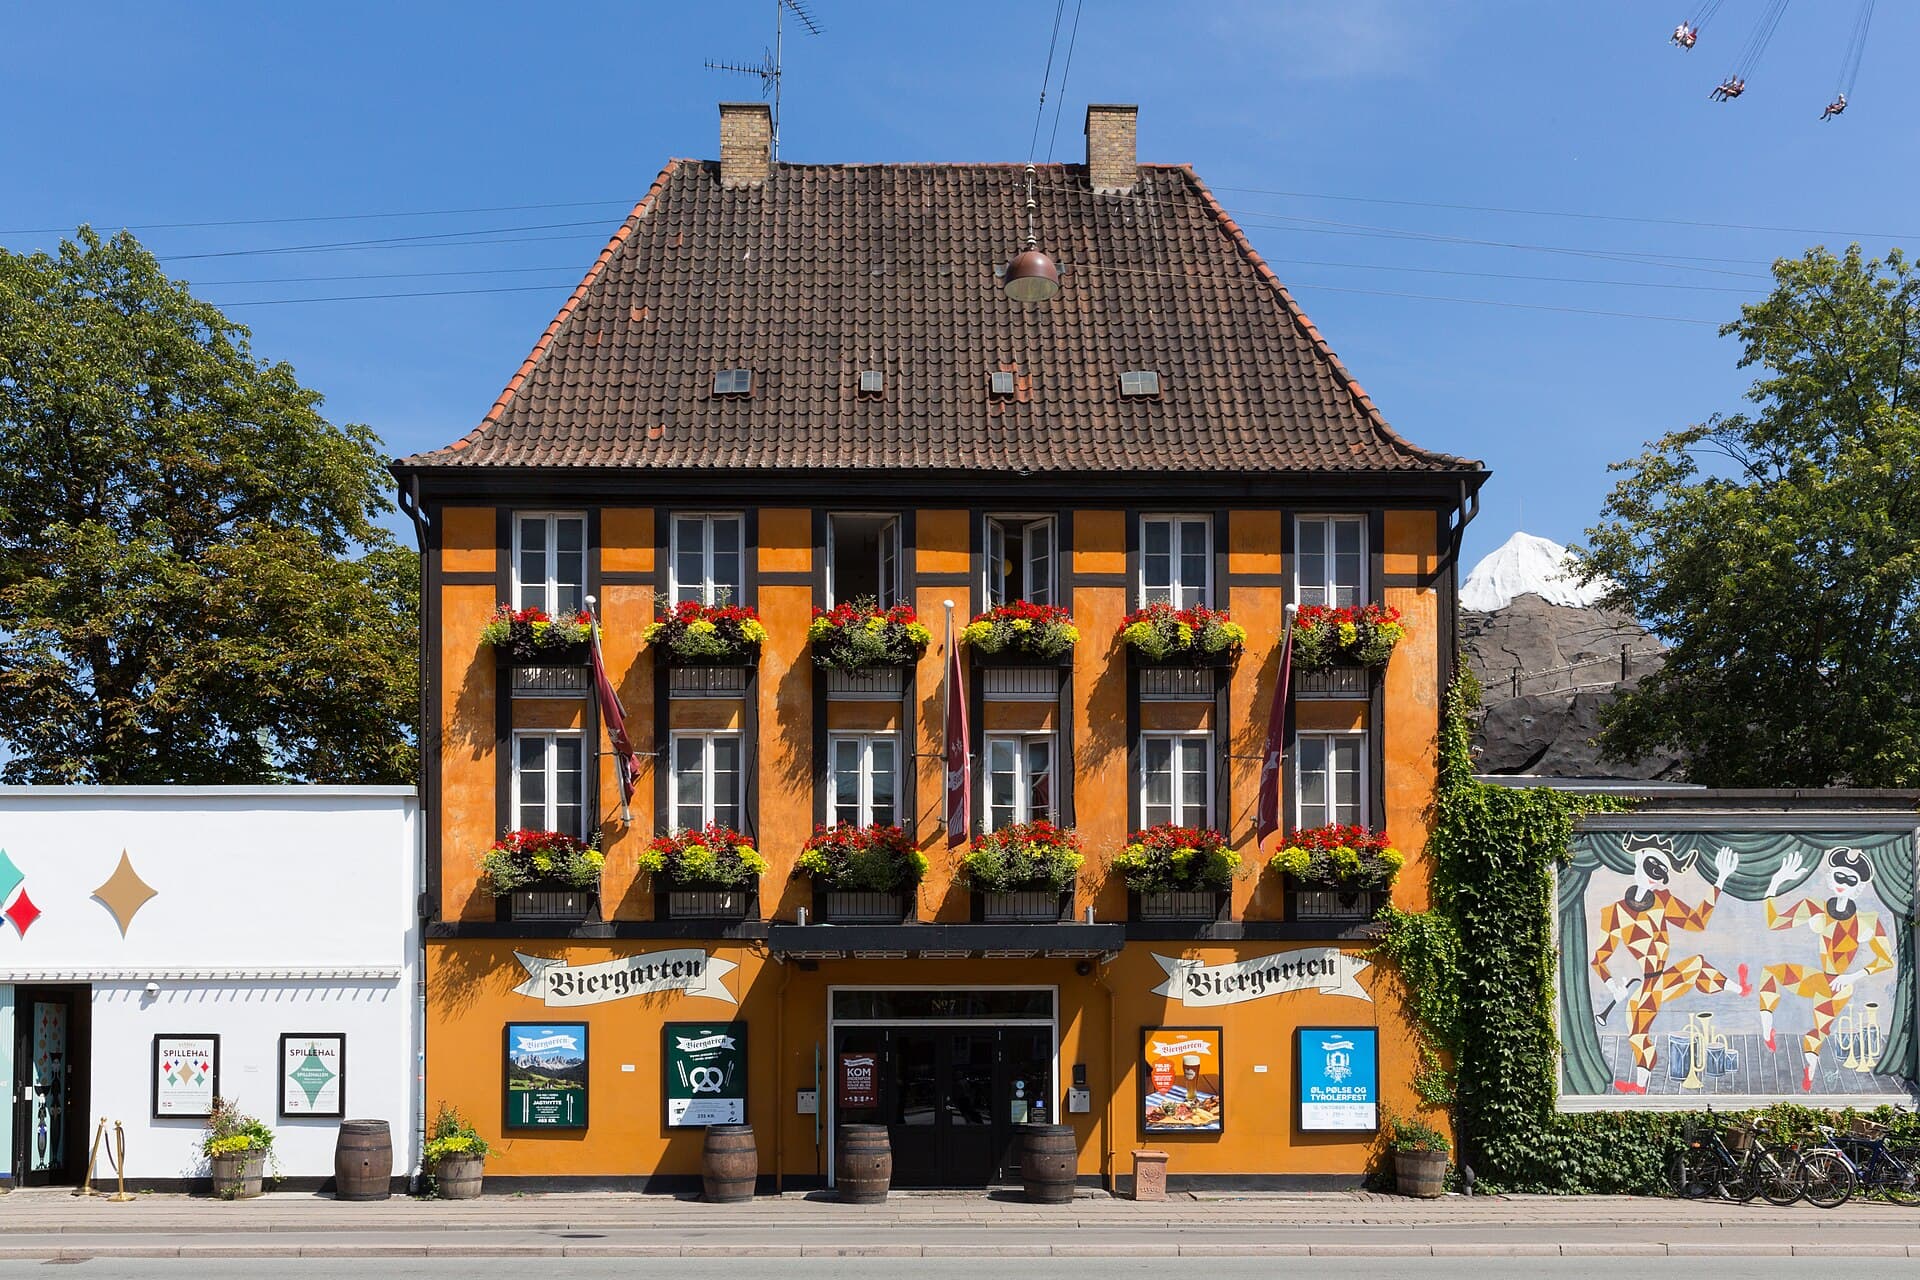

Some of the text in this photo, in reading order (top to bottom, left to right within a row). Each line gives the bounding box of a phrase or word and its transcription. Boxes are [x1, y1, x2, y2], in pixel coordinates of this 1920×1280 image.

[549, 956, 701, 997] Biergarten
[1186, 955, 1336, 997] Biergarten
[526, 1036, 569, 1049] Biergarten
[685, 1036, 727, 1049] Biergarten
[1161, 1041, 1202, 1054] Biergarten
[163, 1049, 209, 1057] SPILLEHAL
[289, 1049, 336, 1057] SPILLEHAL
[847, 1067, 871, 1077] KOM
[1310, 1086, 1367, 1094] ØL, PØLSE OG
